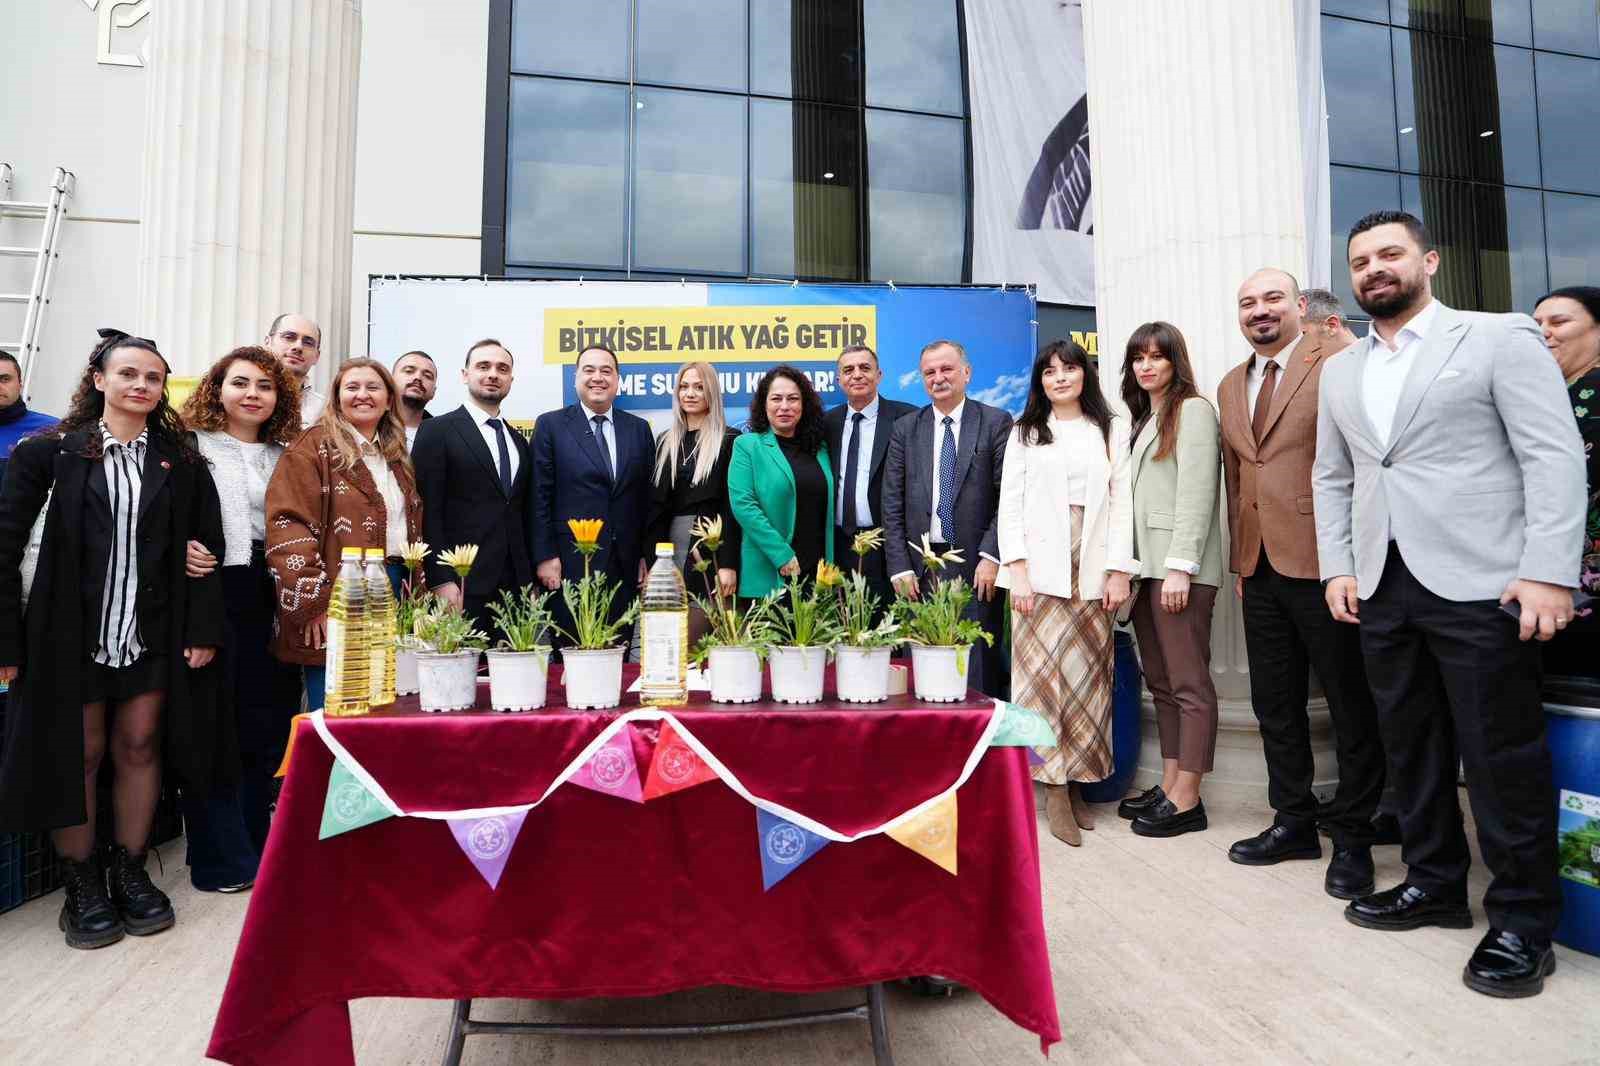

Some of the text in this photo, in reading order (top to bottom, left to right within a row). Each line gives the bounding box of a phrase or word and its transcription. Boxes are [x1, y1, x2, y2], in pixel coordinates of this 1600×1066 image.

[559, 316, 868, 353] BİTKİSEL ATIK YAĞ GETİR
